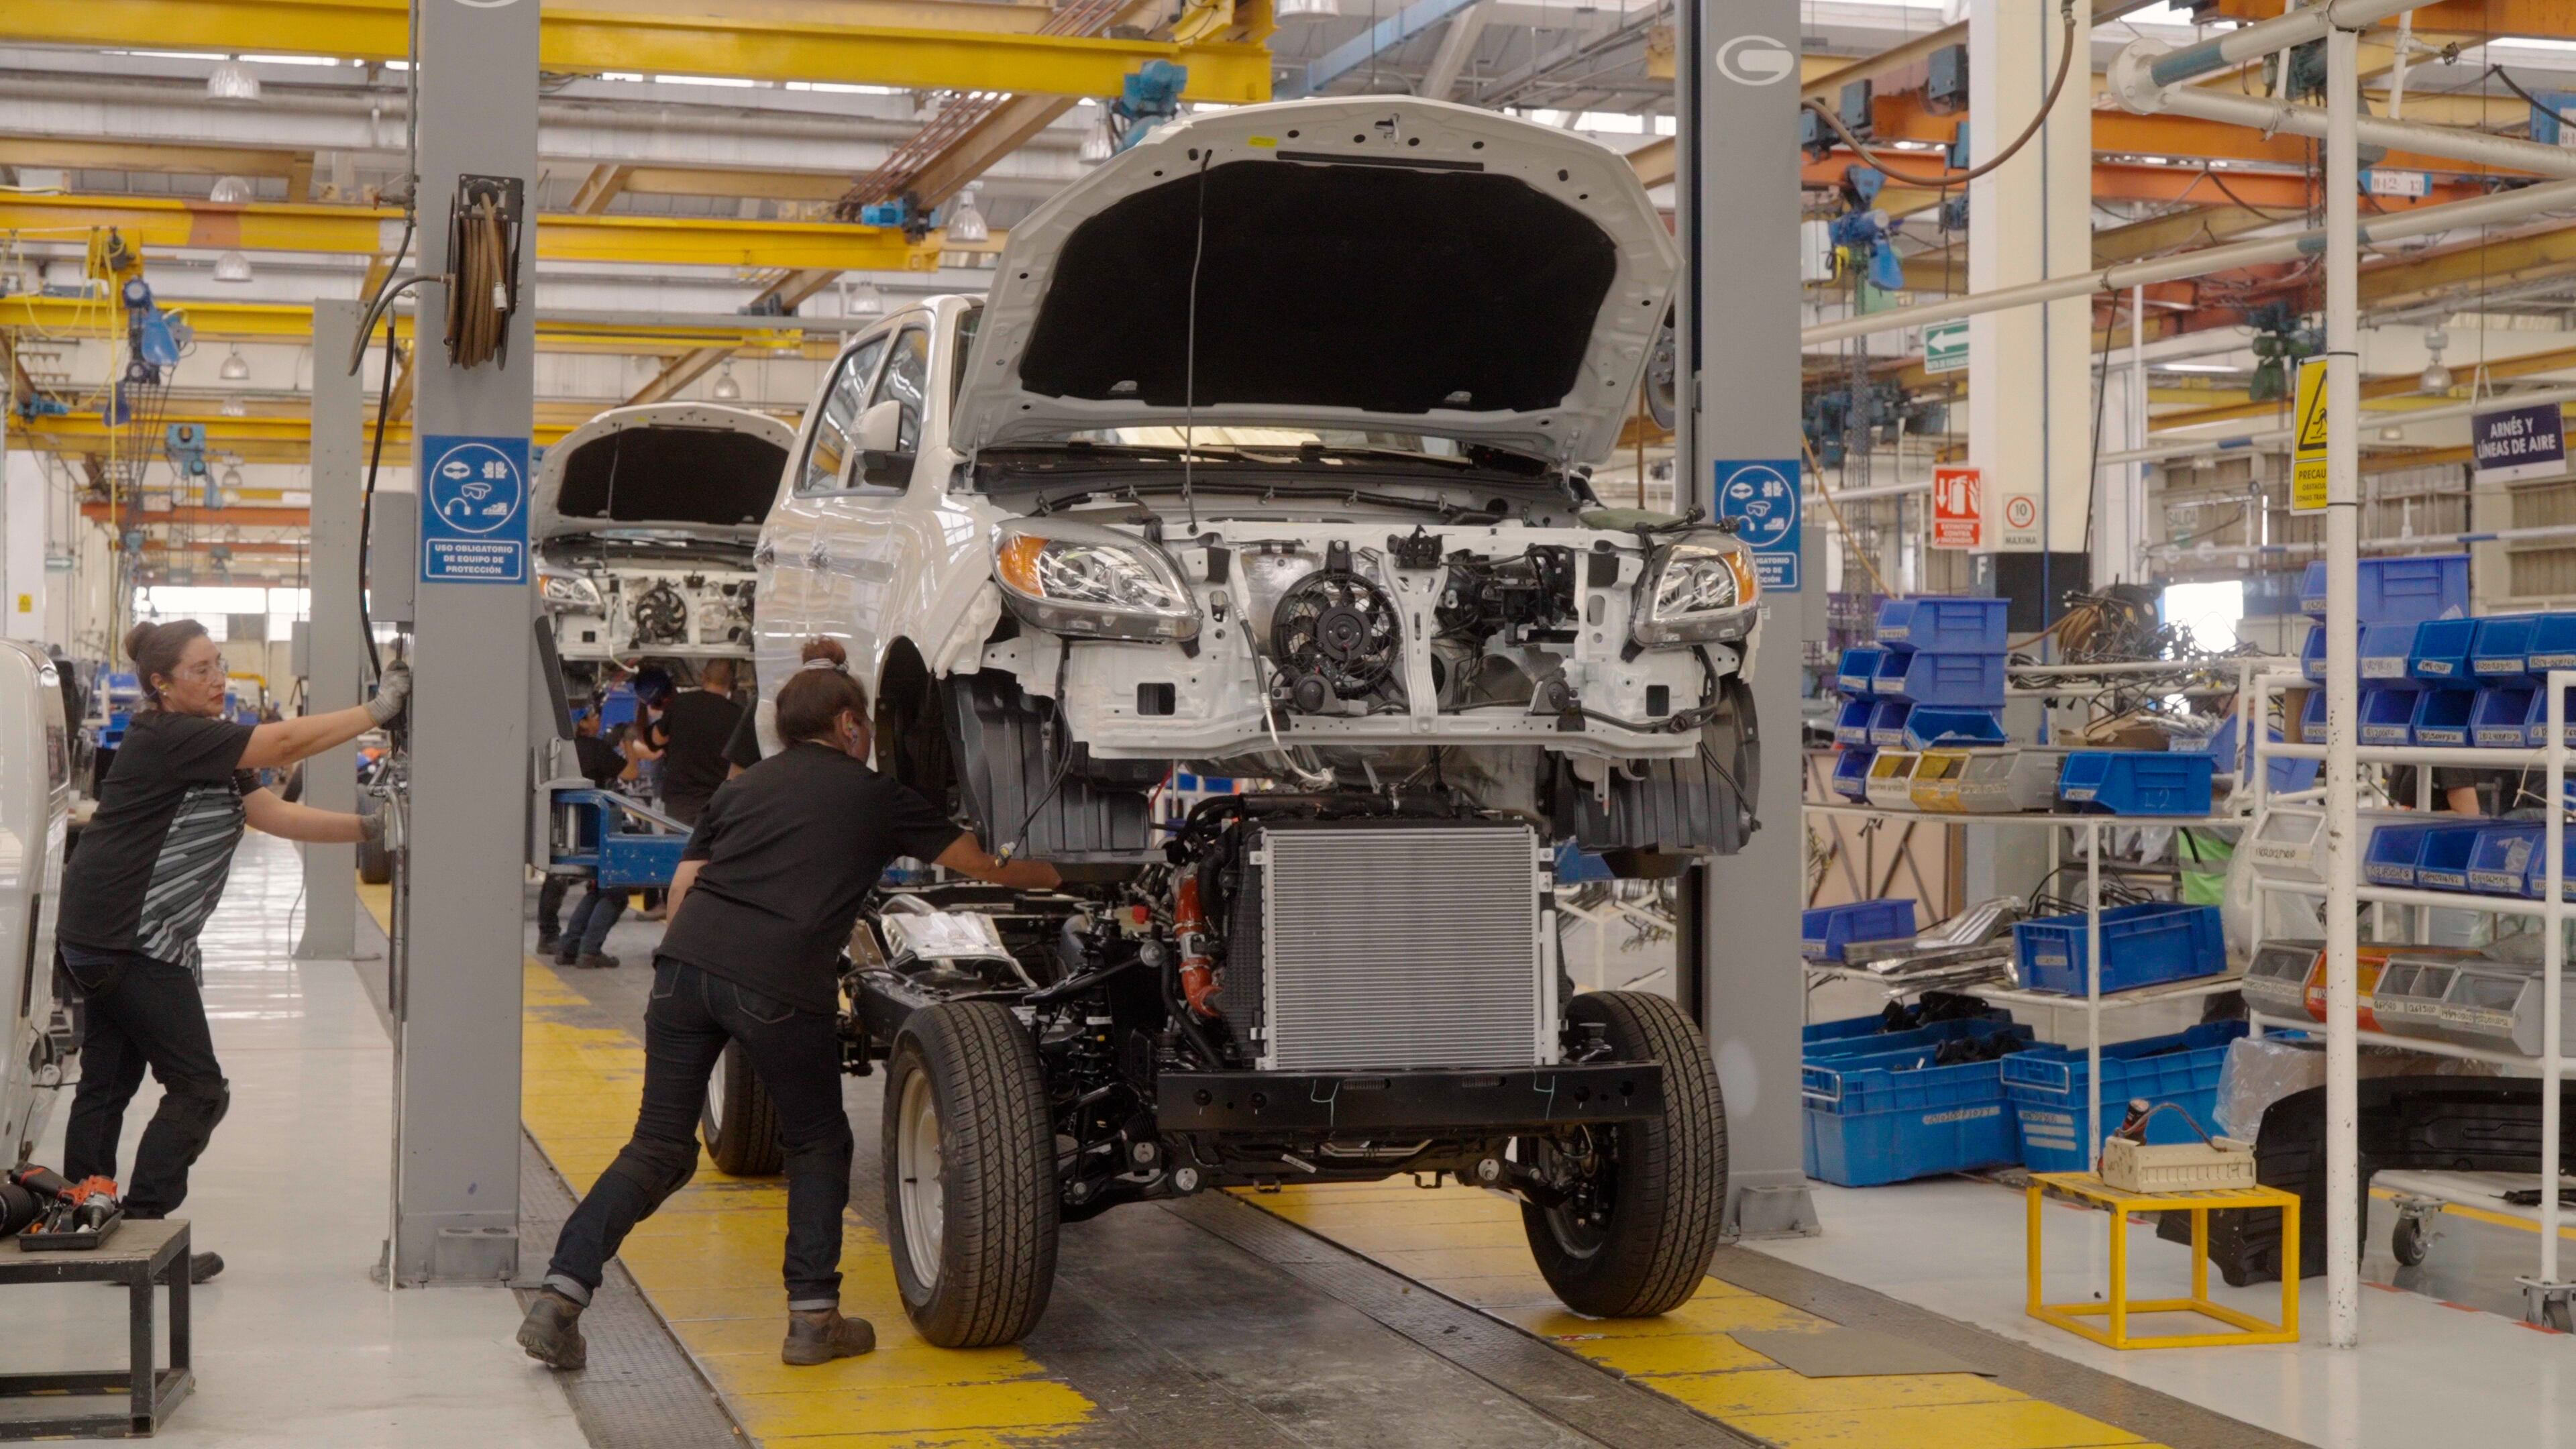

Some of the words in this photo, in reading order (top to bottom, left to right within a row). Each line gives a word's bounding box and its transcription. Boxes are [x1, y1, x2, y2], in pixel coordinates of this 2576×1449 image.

[2490, 415, 2524, 439] ARNÉS
[2525, 417, 2534, 433] Y
[2477, 438, 2510, 460] LÍNEAS
[2511, 437, 2526, 455] DE
[2528, 433, 2556, 453] AIRE
[2015, 503, 2027, 517] 10
[435, 544, 453, 552] USO
[455, 544, 513, 553] OBLIGATORIO
[458, 555, 490, 564] EQUIPO
[445, 565, 502, 574] PROTECCIÓN
